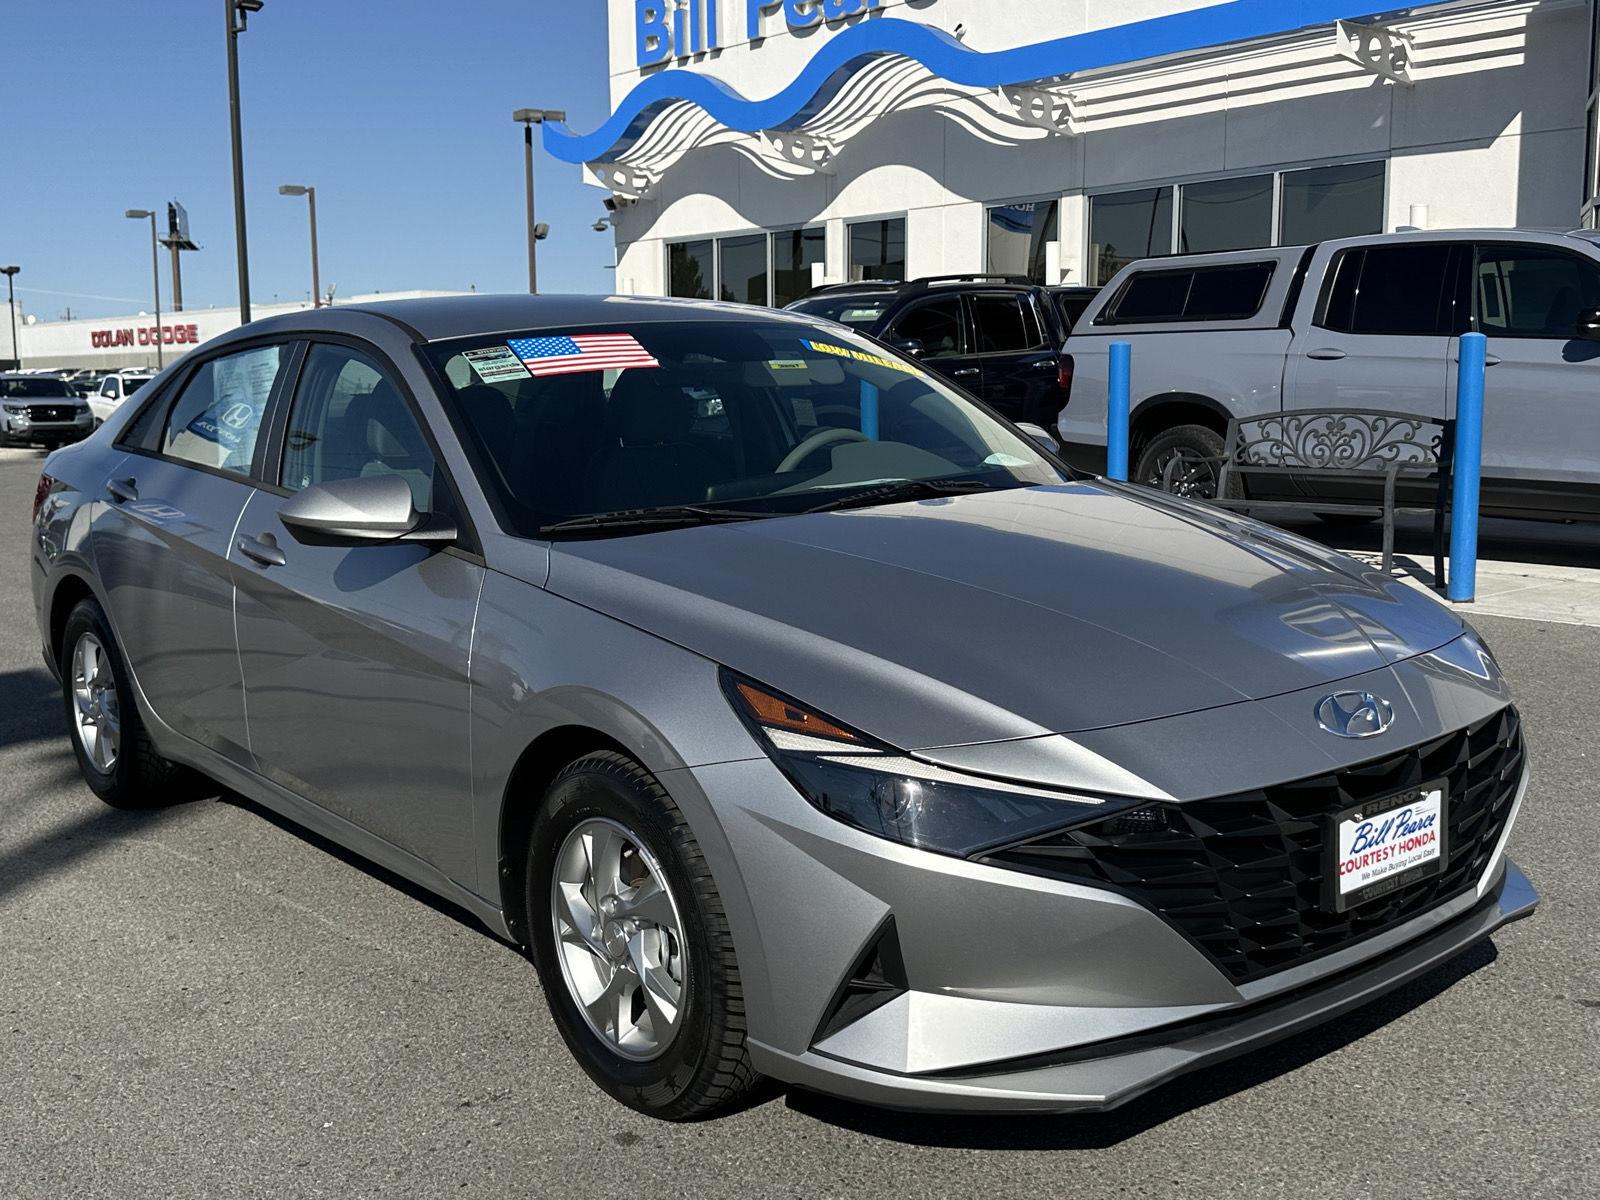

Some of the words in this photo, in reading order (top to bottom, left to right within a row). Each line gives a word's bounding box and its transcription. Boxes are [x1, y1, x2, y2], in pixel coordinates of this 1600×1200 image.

[636, 0, 717, 67] Bill
[91, 329, 134, 348] DOLAN
[137, 324, 199, 346] DODGE
[1366, 790, 1418, 815] RENO
[1349, 817, 1395, 855] Bill
[1392, 808, 1436, 840] Pearce
[1338, 844, 1397, 876] COURTESY
[1399, 830, 1436, 855] HONDA
[1361, 871, 1371, 881] We
[1372, 866, 1387, 879] Make
[1388, 859, 1407, 873] Buying
[1408, 852, 1422, 865] Local
